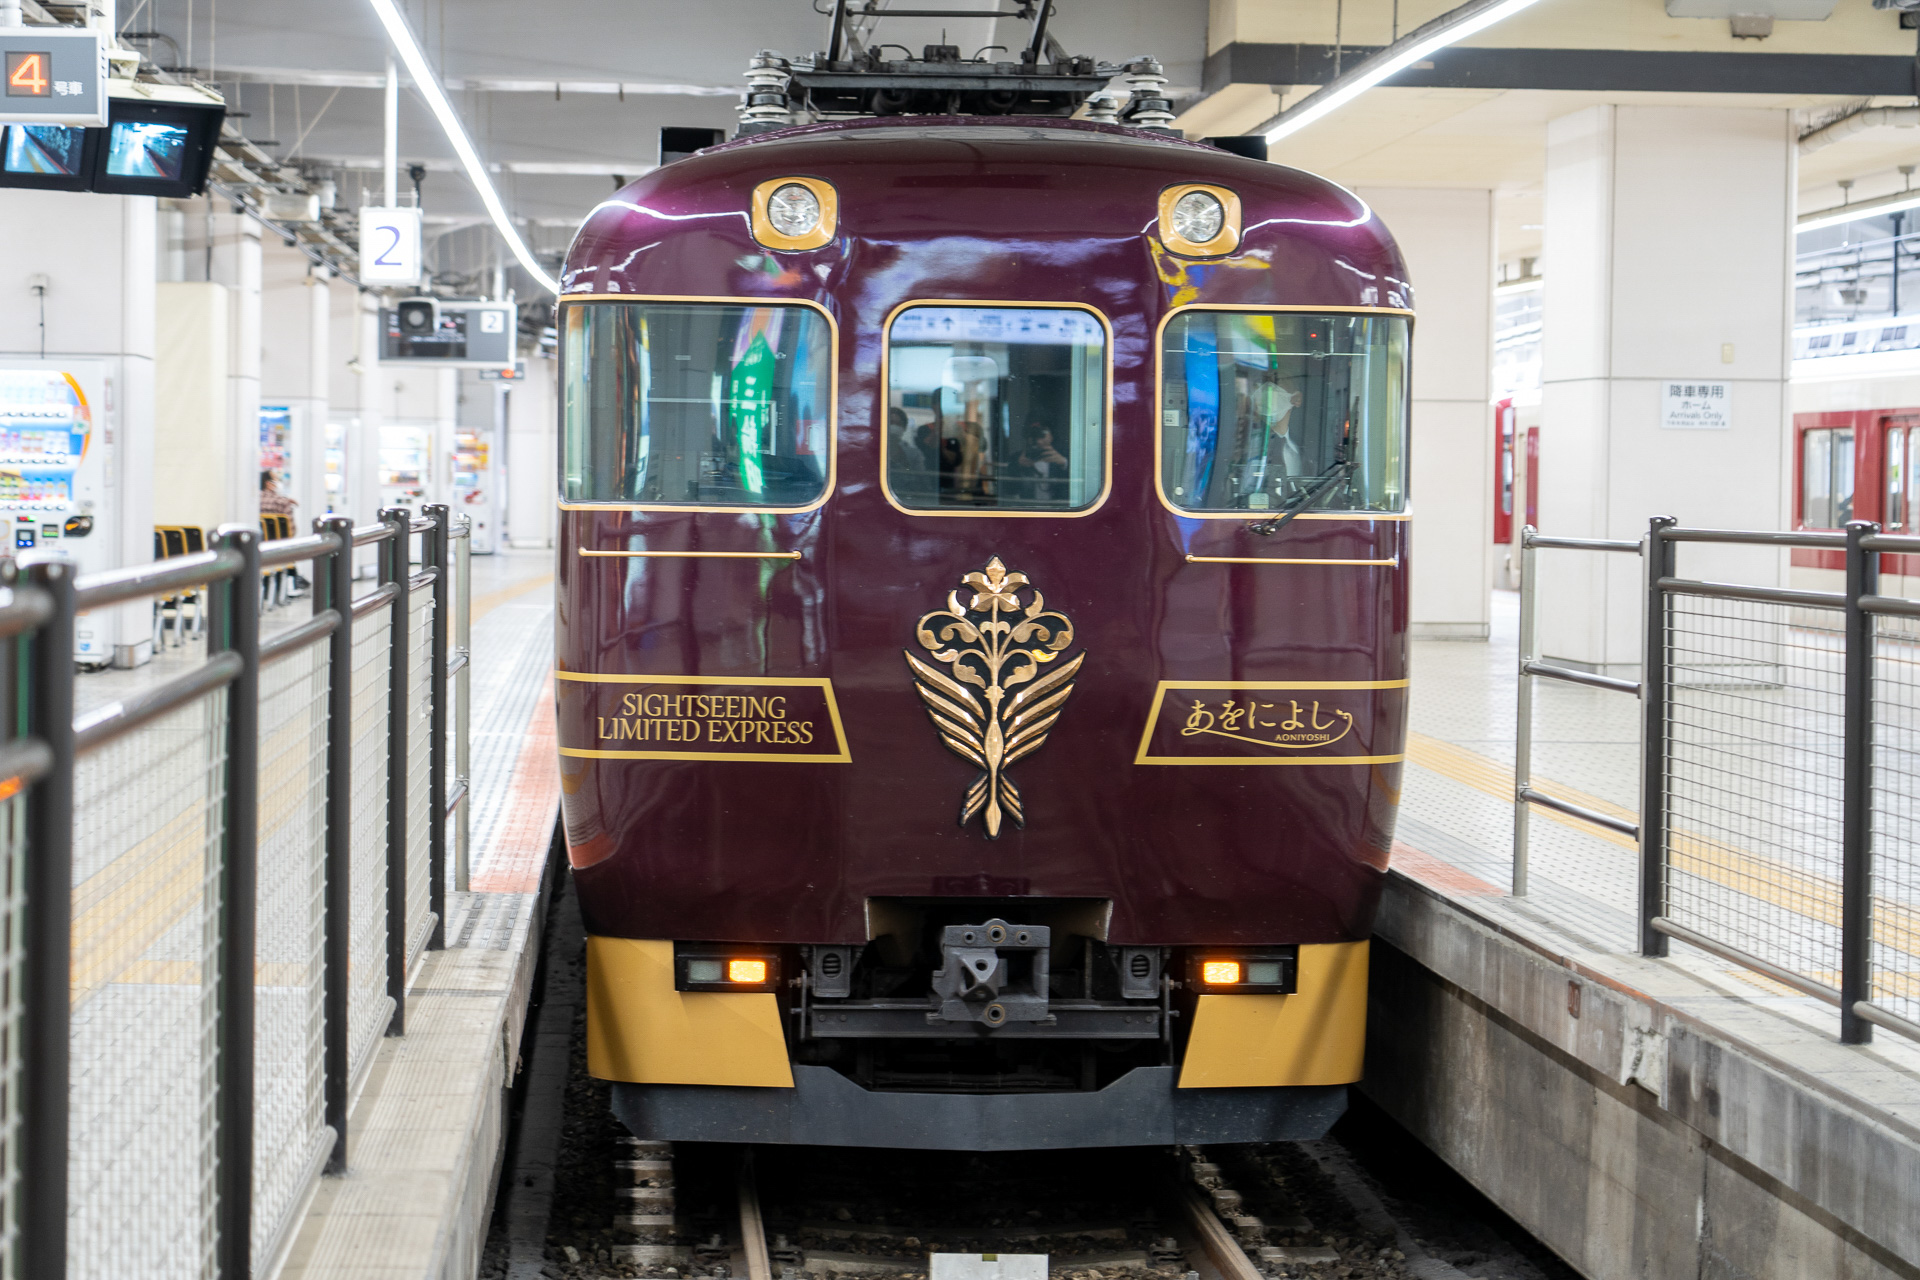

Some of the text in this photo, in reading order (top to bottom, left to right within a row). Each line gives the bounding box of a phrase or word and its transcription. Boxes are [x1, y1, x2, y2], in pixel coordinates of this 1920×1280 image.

[10, 54, 83, 96] 4 号車
[374, 226, 402, 266] 2
[487, 315, 498, 329] 2
[1670, 411, 1722, 421] Arrivals Only
[622, 693, 786, 719] SIGHTSEEING
[1181, 700, 1338, 736] あをによし
[597, 716, 813, 744] LIMITED EXPRESS
[1275, 733, 1330, 742] AONIYOSHI
